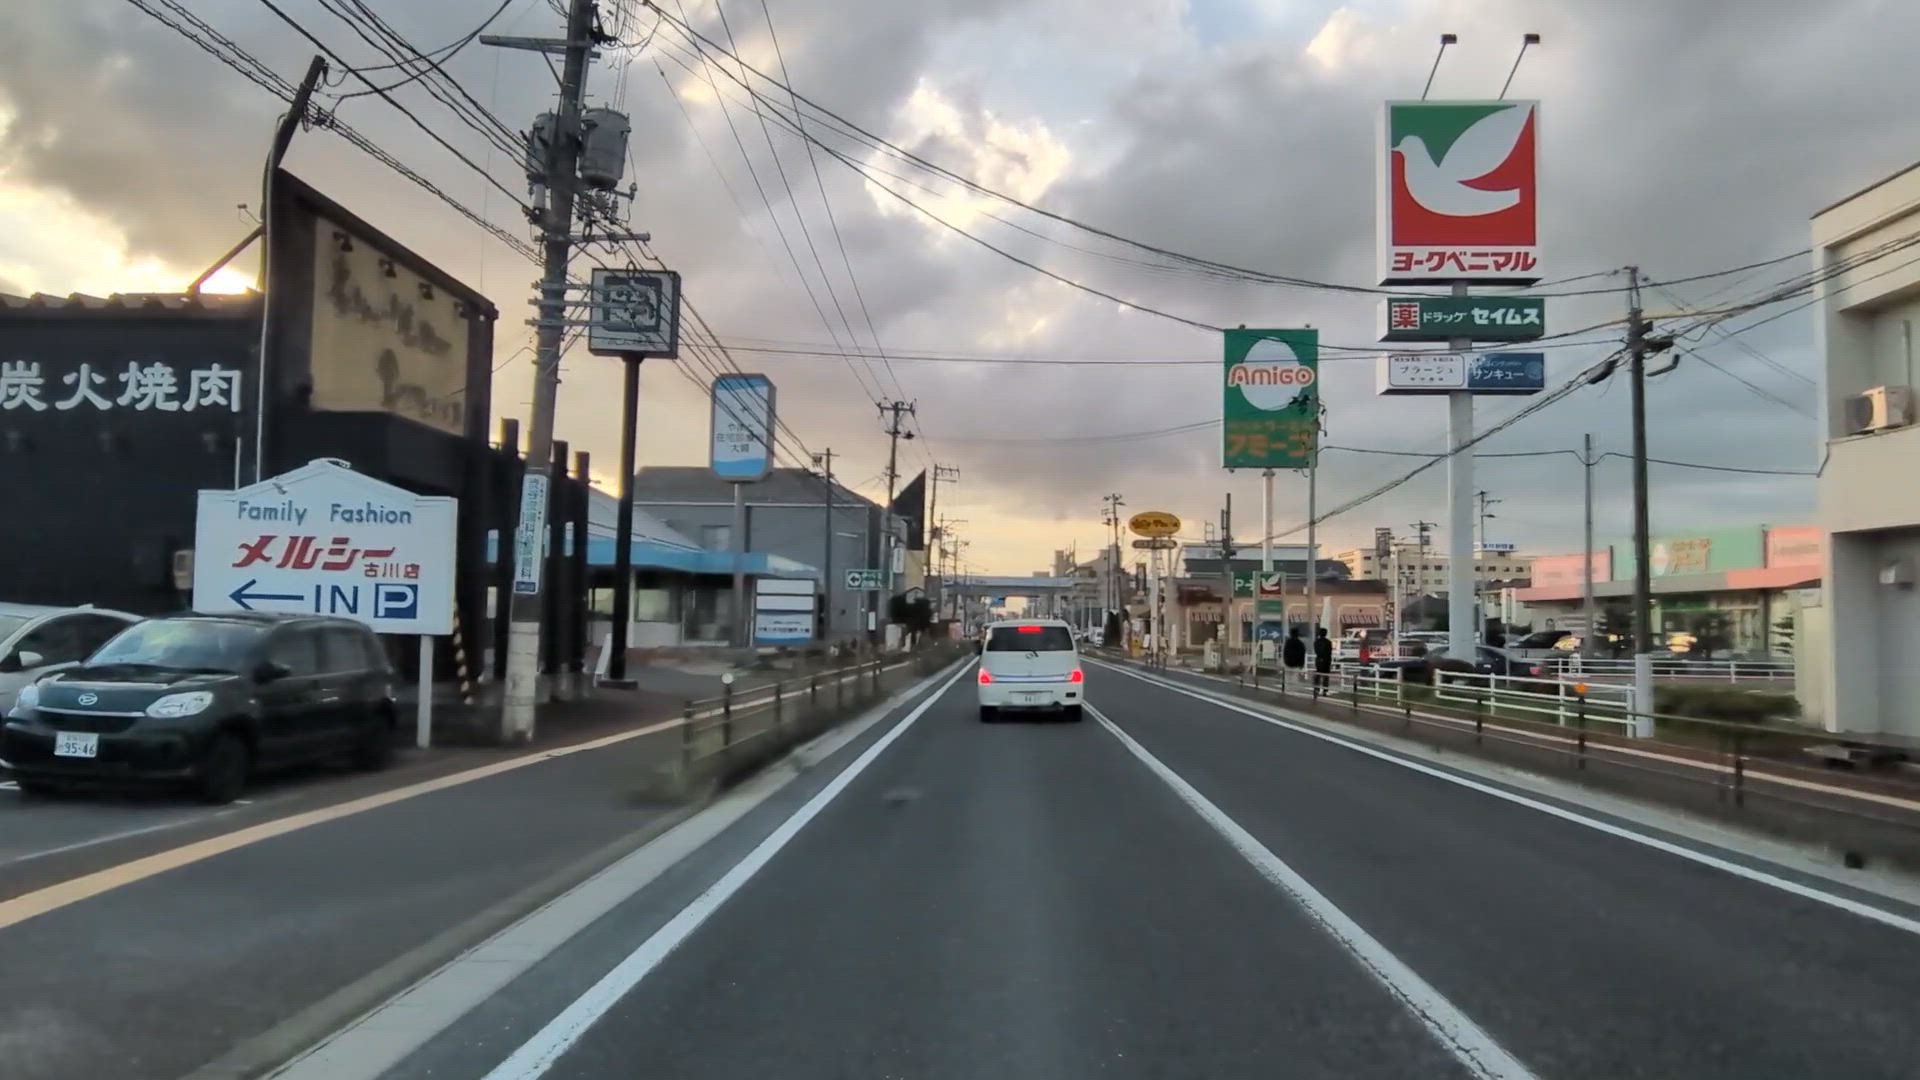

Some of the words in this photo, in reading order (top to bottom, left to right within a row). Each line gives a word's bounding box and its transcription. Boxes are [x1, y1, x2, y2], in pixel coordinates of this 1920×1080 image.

[1391, 251, 1537, 272] ヨークベニマル
[1393, 303, 1419, 329] 薬
[1471, 307, 1540, 325] セイムス
[0, 360, 242, 412] 炭火焼肉
[238, 500, 307, 526] Family
[330, 502, 412, 524] Fashion
[232, 535, 396, 571] メルシー
[363, 562, 420, 579] 古川店
[315, 584, 359, 614] IN
